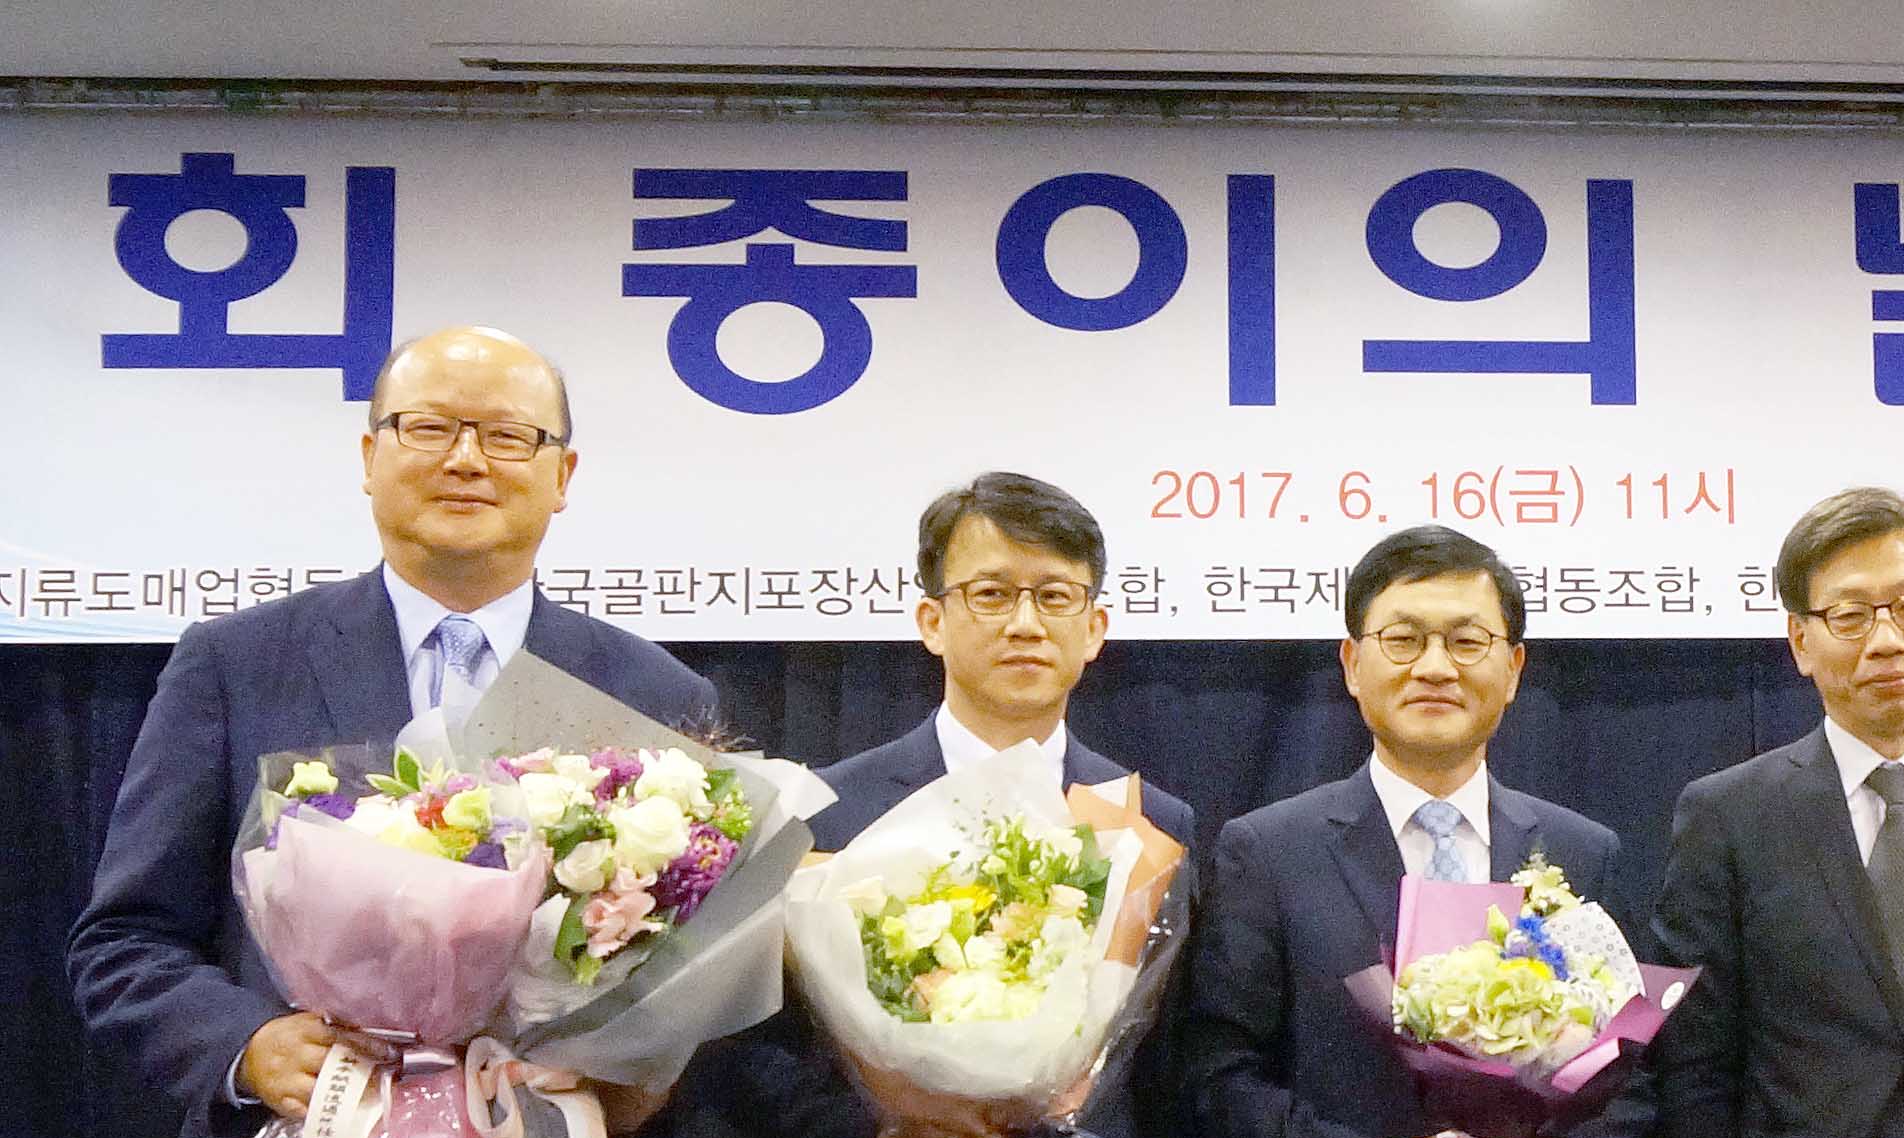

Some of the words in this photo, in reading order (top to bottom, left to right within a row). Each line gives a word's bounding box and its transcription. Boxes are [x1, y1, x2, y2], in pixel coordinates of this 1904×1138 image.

[102, 152, 396, 402] 회
[623, 168, 1637, 415] 종이의
[1151, 471, 1309, 523] 2017.
[1338, 471, 1388, 523] 6.
[1423, 465, 1585, 527] 16(금)
[1616, 468, 1735, 524] 11시
